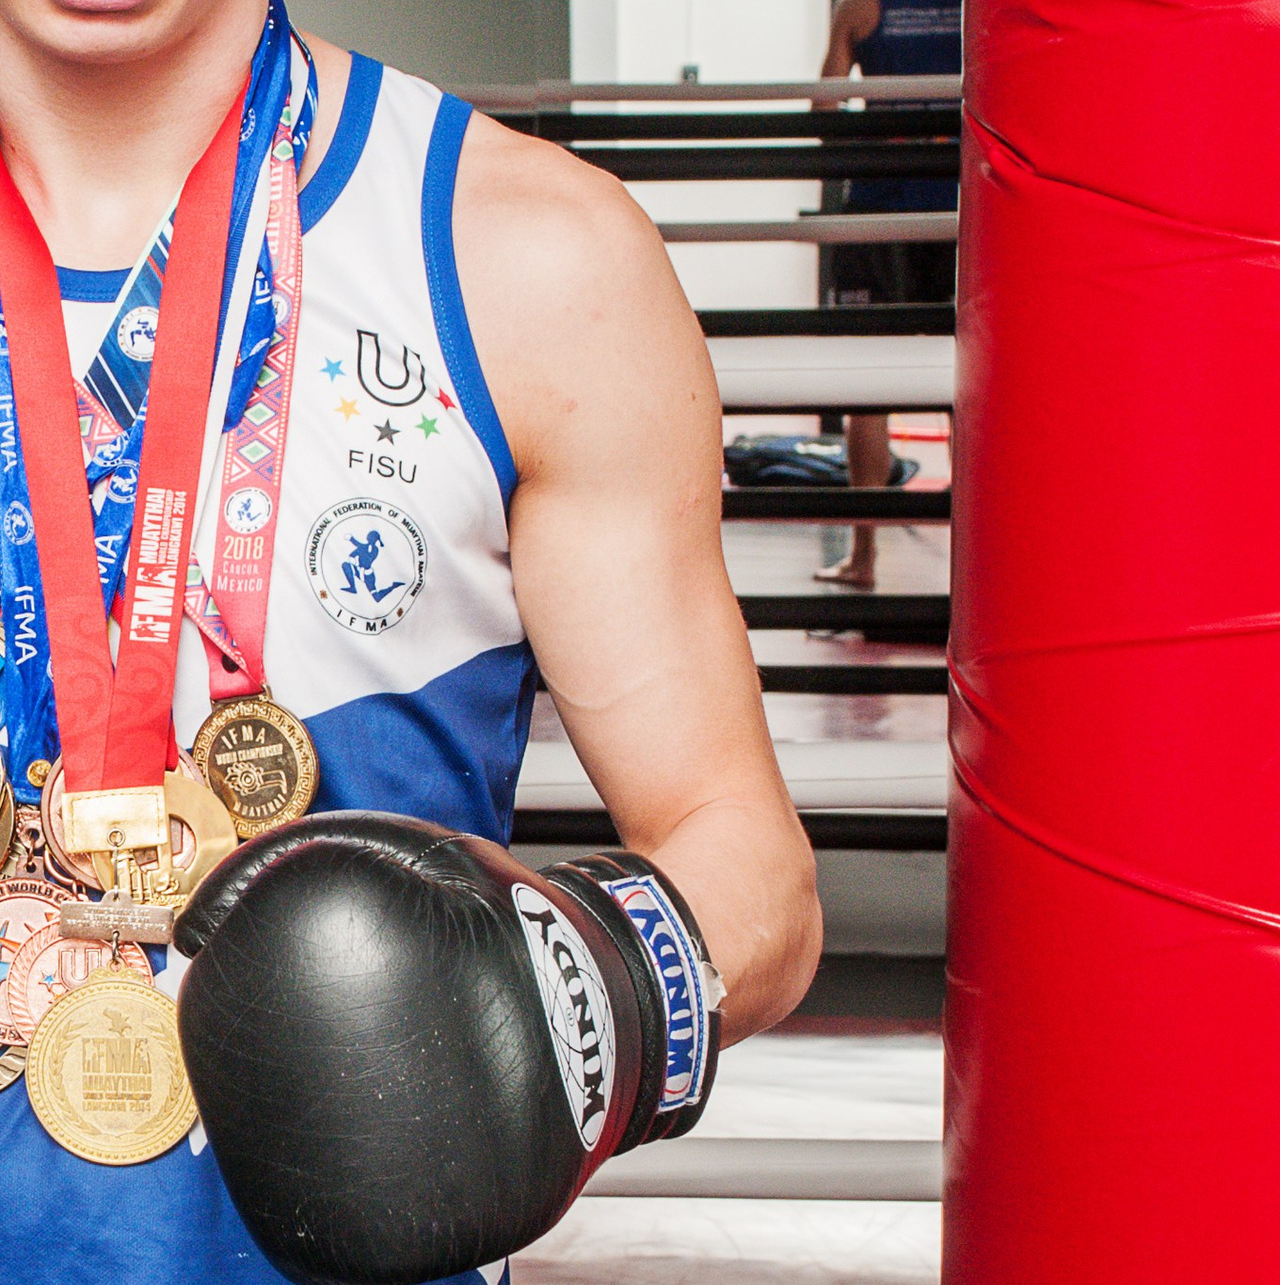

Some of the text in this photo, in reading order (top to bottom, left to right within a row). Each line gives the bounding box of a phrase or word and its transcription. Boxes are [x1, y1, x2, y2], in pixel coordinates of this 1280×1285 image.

[348, 449, 417, 484] FISU
[140, 488, 166, 564] MUAYTHAI
[166, 490, 187, 565] LANGKAWI 2014
[308, 518, 332, 576] INTERNATIONAL
[333, 501, 382, 518] FEDERATION
[388, 509, 400, 519] OF
[223, 535, 264, 560] 2018
[217, 575, 263, 592] MEXICO
[14, 586, 38, 665] IFMA
[221, 724, 266, 750] IFMA
[238, 744, 283, 761] CHAMPIONSHIP
[233, 793, 286, 817] MUAYTHAI
[6, 882, 53, 899] WORLD
[629, 907, 695, 1079] WINDY
[520, 909, 605, 1129] WINDY
